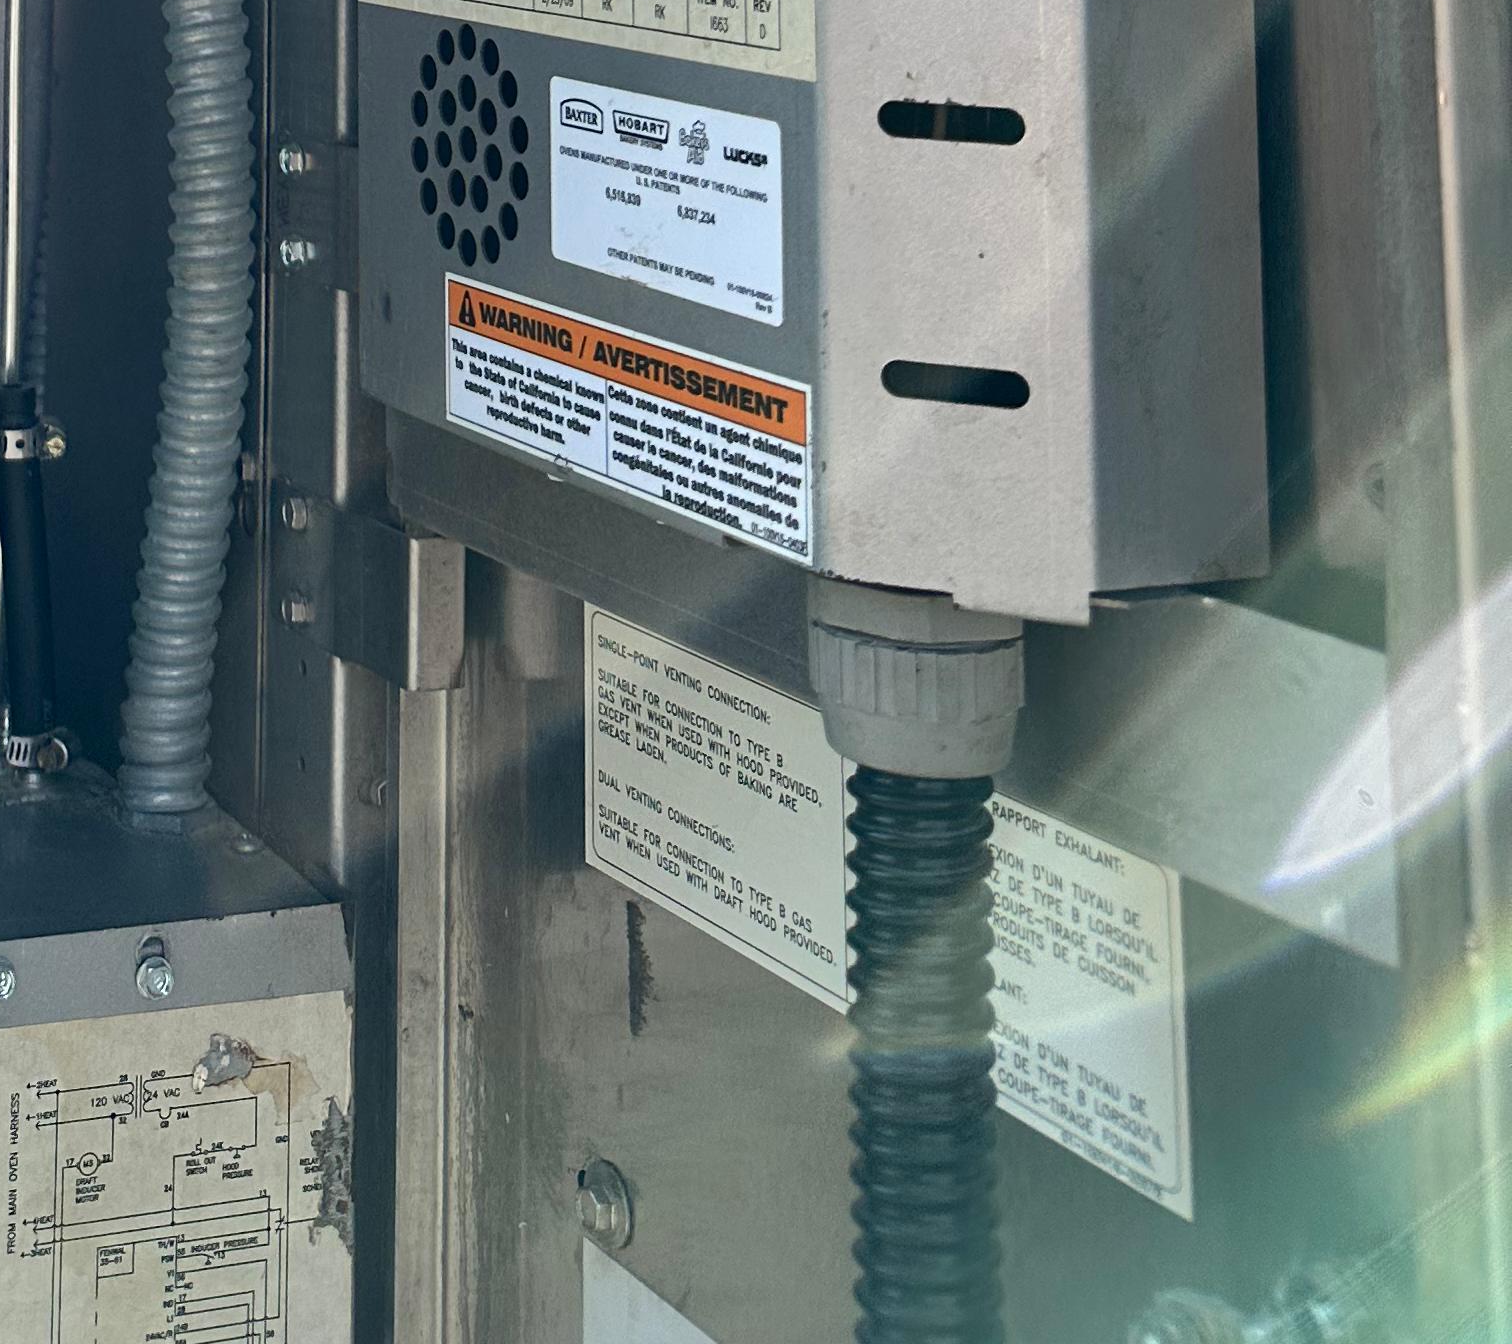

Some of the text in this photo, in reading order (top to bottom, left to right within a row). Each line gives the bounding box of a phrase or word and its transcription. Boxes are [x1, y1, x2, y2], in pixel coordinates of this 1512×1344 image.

[565, 106, 597, 126] BAXTER
[618, 114, 664, 137] HOBART
[451, 337, 604, 405] This area contains a chemical known
[455, 356, 600, 423] to the State of California to cause
[479, 300, 788, 427] WARNING / AVERTISSEMENT
[464, 376, 591, 438] cancer, birth defects or other
[486, 402, 564, 446] reproductive harm.
[608, 383, 802, 467] Cette zone contient un agent chimique
[608, 404, 638, 432] connu
[640, 415, 663, 441] dans
[693, 434, 706, 457] de
[708, 439, 719, 461] la
[721, 444, 773, 481] Californie
[775, 463, 801, 491] pour
[613, 426, 797, 511] causer le cancer, des malformations
[662, 484, 742, 530] la reproduction.
[676, 469, 688, 491] ou
[691, 475, 724, 505] autres
[726, 488, 782, 527] anomalies
[784, 510, 799, 534] de
[598, 667, 783, 769] SUITABLE FOR CONNECTION TO TYPE B
[598, 683, 614, 705] GAS
[620, 694, 642, 718] VENT
[647, 707, 672, 734] WHEN
[678, 723, 702, 748] USED
[707, 737, 730, 763] WITH
[736, 751, 763, 779] HOOD
[664, 663, 701, 695] VENTING
[707, 683, 770, 727] CONNECTION:
[598, 716, 667, 766] GREASE LADEN.
[598, 700, 798, 814] EXCEPT WHEN PRODUCTS OF BAKING ARE
[598, 768, 735, 855] DUAL VENTING CONNECTIONS:
[991, 799, 1125, 877] RAPPORT EXHALANT:
[598, 820, 837, 968] VENT WHEN USED WITH DRAFT HOOD PROVIDED.
[1008, 874, 1158, 964] DE TYPE B LORSQU'IL
[1032, 863, 1140, 931] D'UN TUYAU DE
[991, 909, 1136, 999] RODUITS DE CUISSON
[90, 1093, 130, 1108] 120 VAC
[147, 1086, 180, 1101] 24 VAC
[6, 1092, 20, 1254] FROM MAIN OVEN HARNESS
